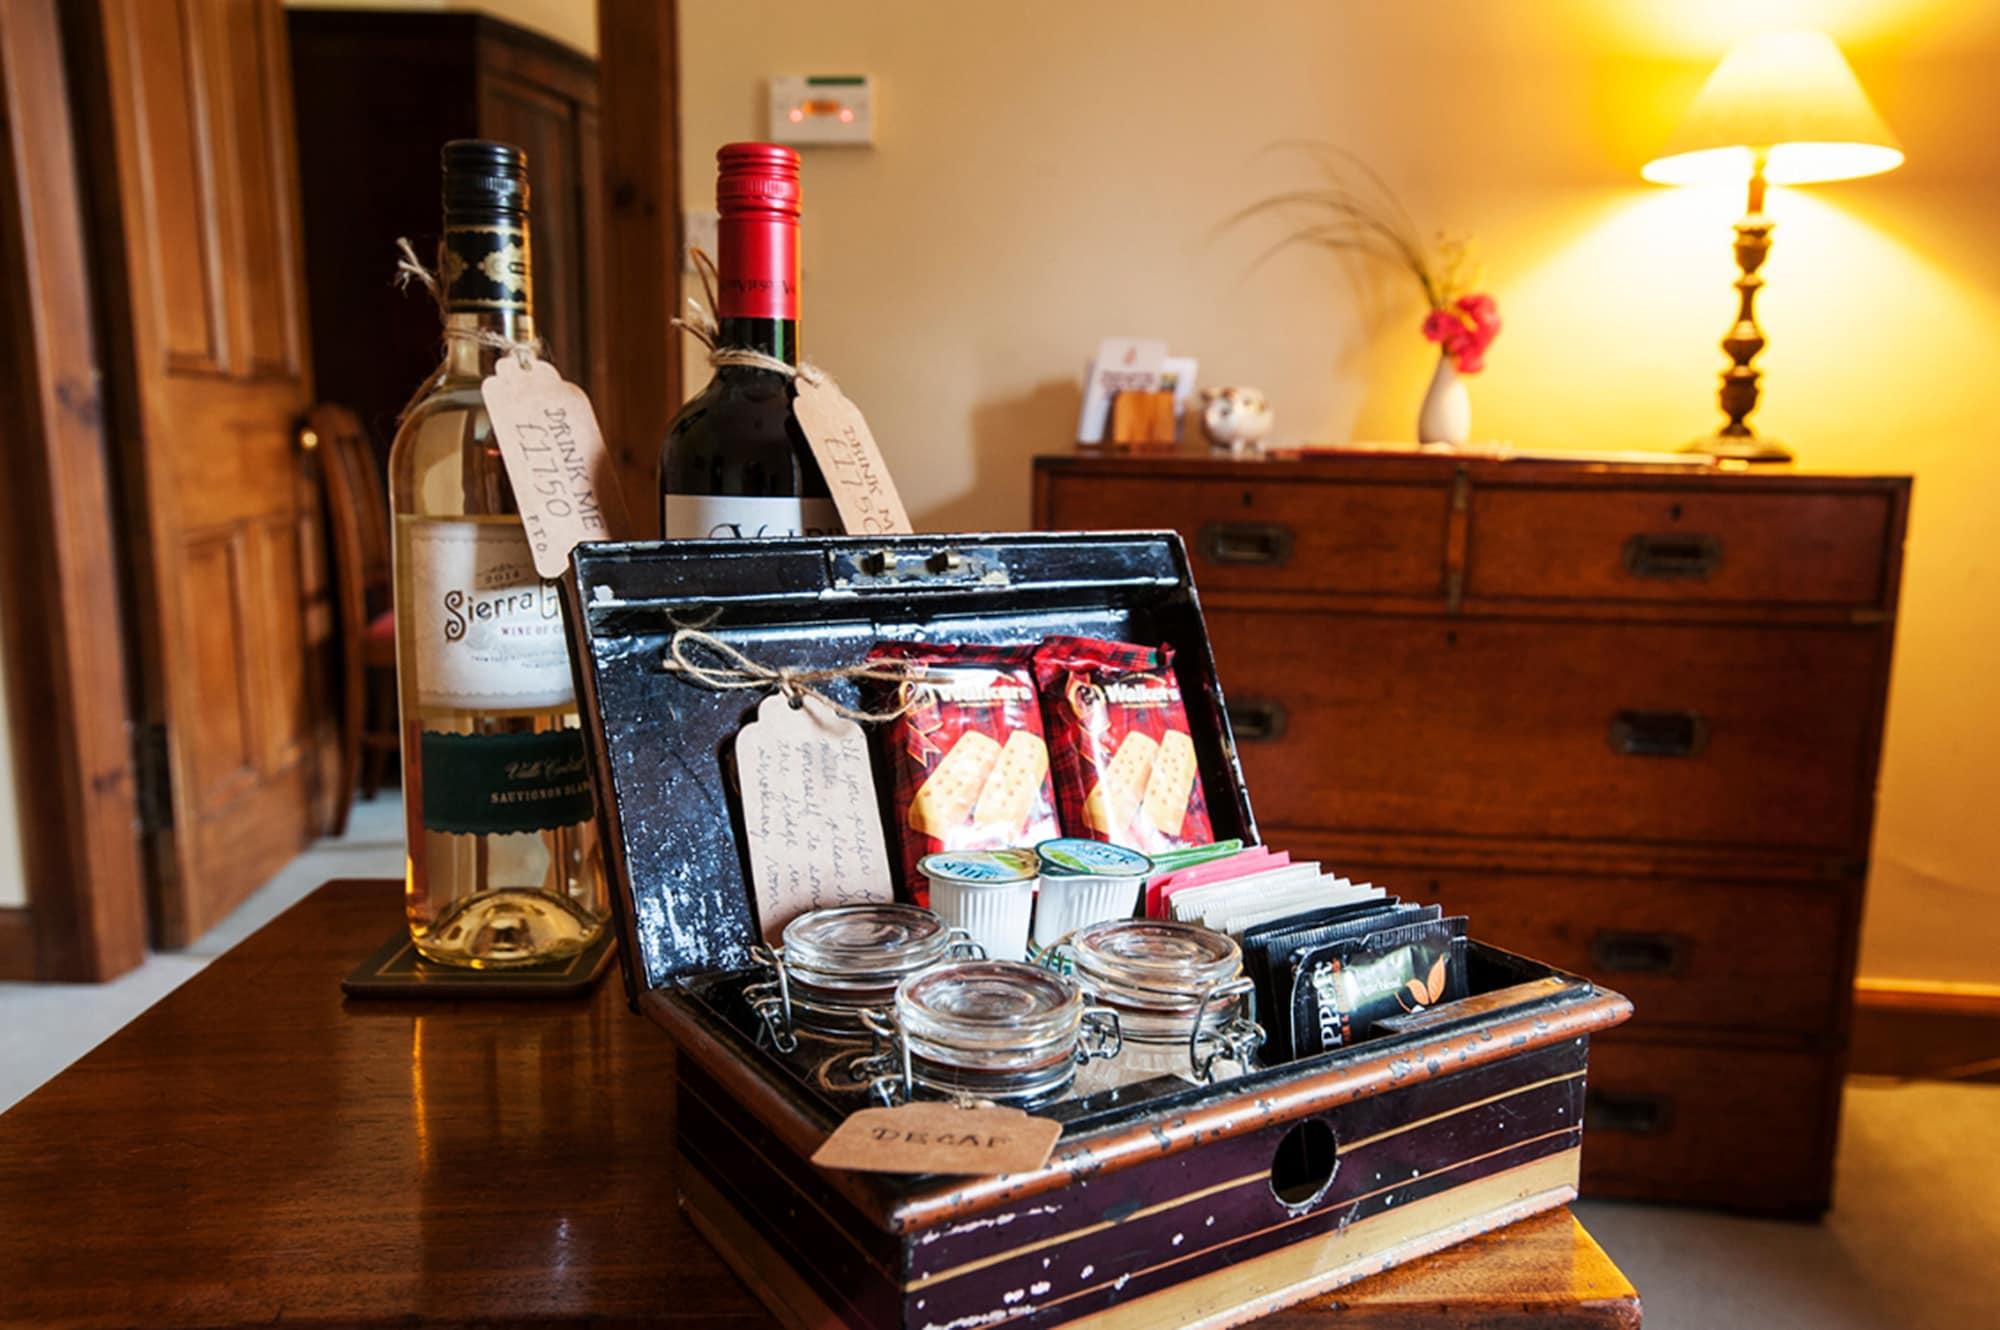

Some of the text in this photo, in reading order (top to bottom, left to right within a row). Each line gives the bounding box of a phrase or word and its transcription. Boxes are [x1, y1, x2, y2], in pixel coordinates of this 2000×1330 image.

[544, 408, 605, 531] DRINK ME
[843, 424, 884, 497] DRINK
[444, 590, 533, 643] Sierra
[501, 625, 533, 636] WINE
[1104, 682, 1181, 703] Walkers
[490, 787, 563, 805] SAUVIGNON
[871, 1126, 1014, 1149] DECAF
